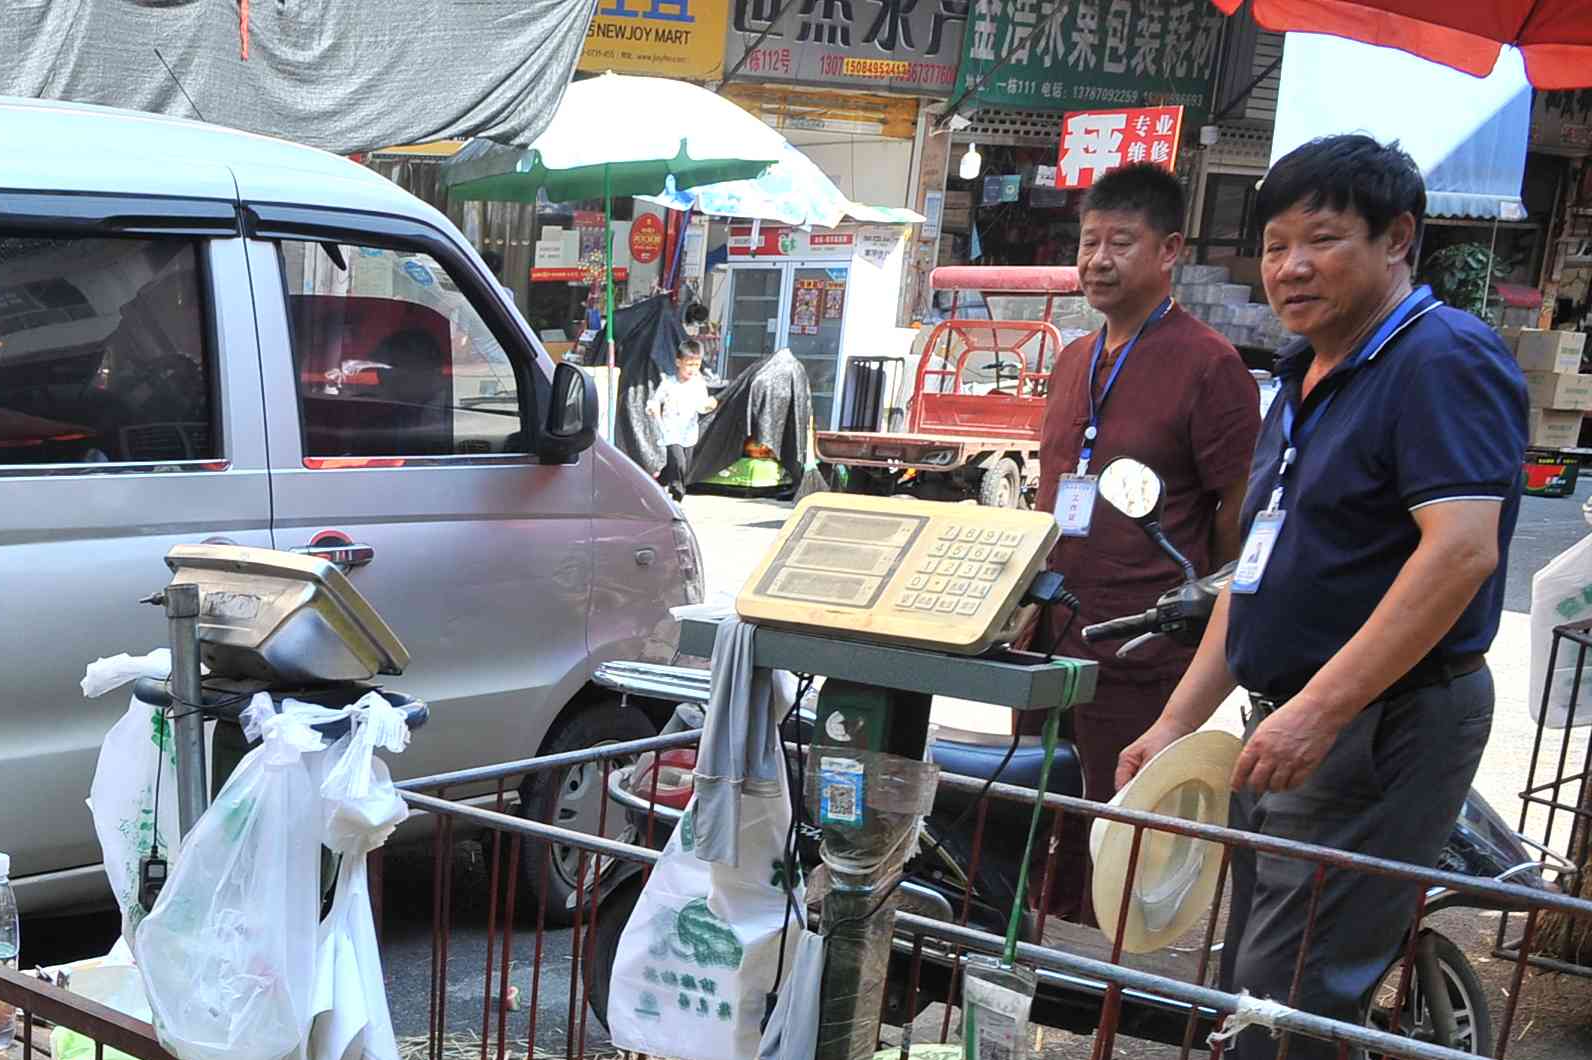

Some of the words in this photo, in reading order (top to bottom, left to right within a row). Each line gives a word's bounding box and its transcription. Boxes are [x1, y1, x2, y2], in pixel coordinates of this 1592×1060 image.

[654, 29, 691, 45] MART
[1131, 114, 1174, 137] 专业
[1060, 113, 1127, 186] 秤
[1127, 139, 1170, 163] 维修
